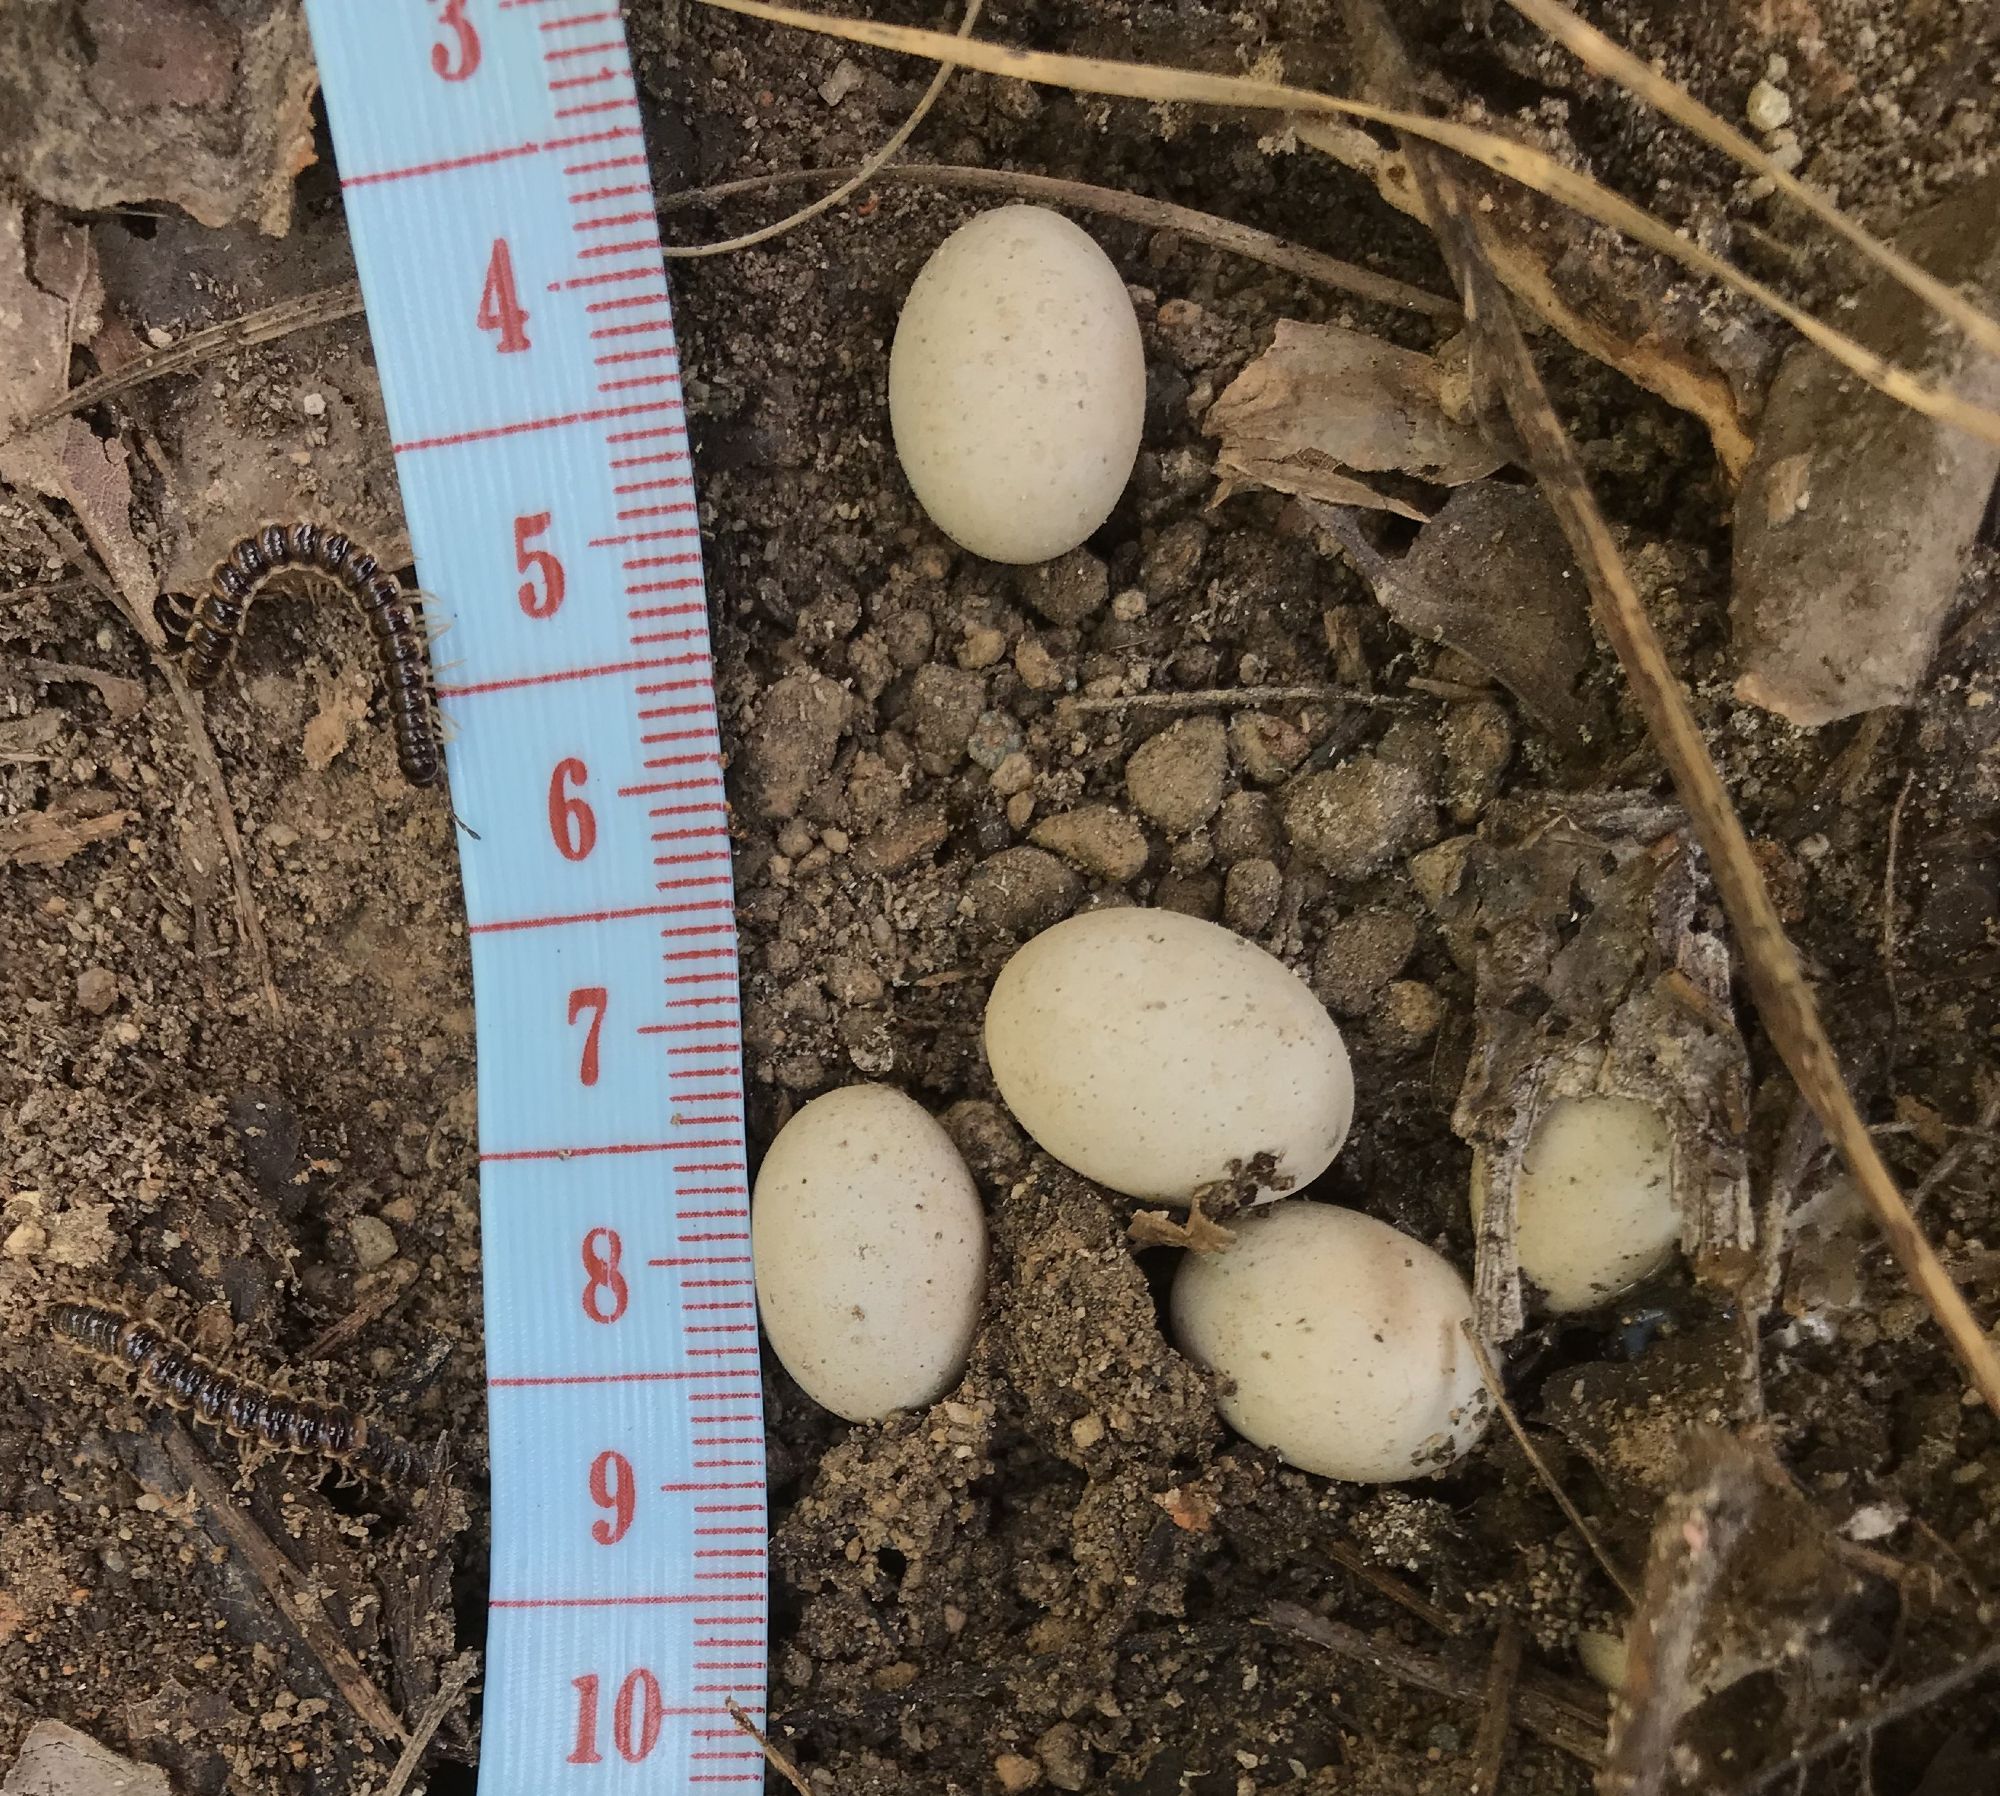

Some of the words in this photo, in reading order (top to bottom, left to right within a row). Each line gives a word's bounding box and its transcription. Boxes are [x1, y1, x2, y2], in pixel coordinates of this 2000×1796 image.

[431, 0, 482, 82] 3
[476, 238, 533, 354] 4
[513, 511, 566, 619] 5
[547, 757, 597, 862] 6
[567, 987, 609, 1087] 7
[581, 1226, 630, 1325] 8
[588, 1450, 637, 1546] 9
[565, 1667, 662, 1765] 10
